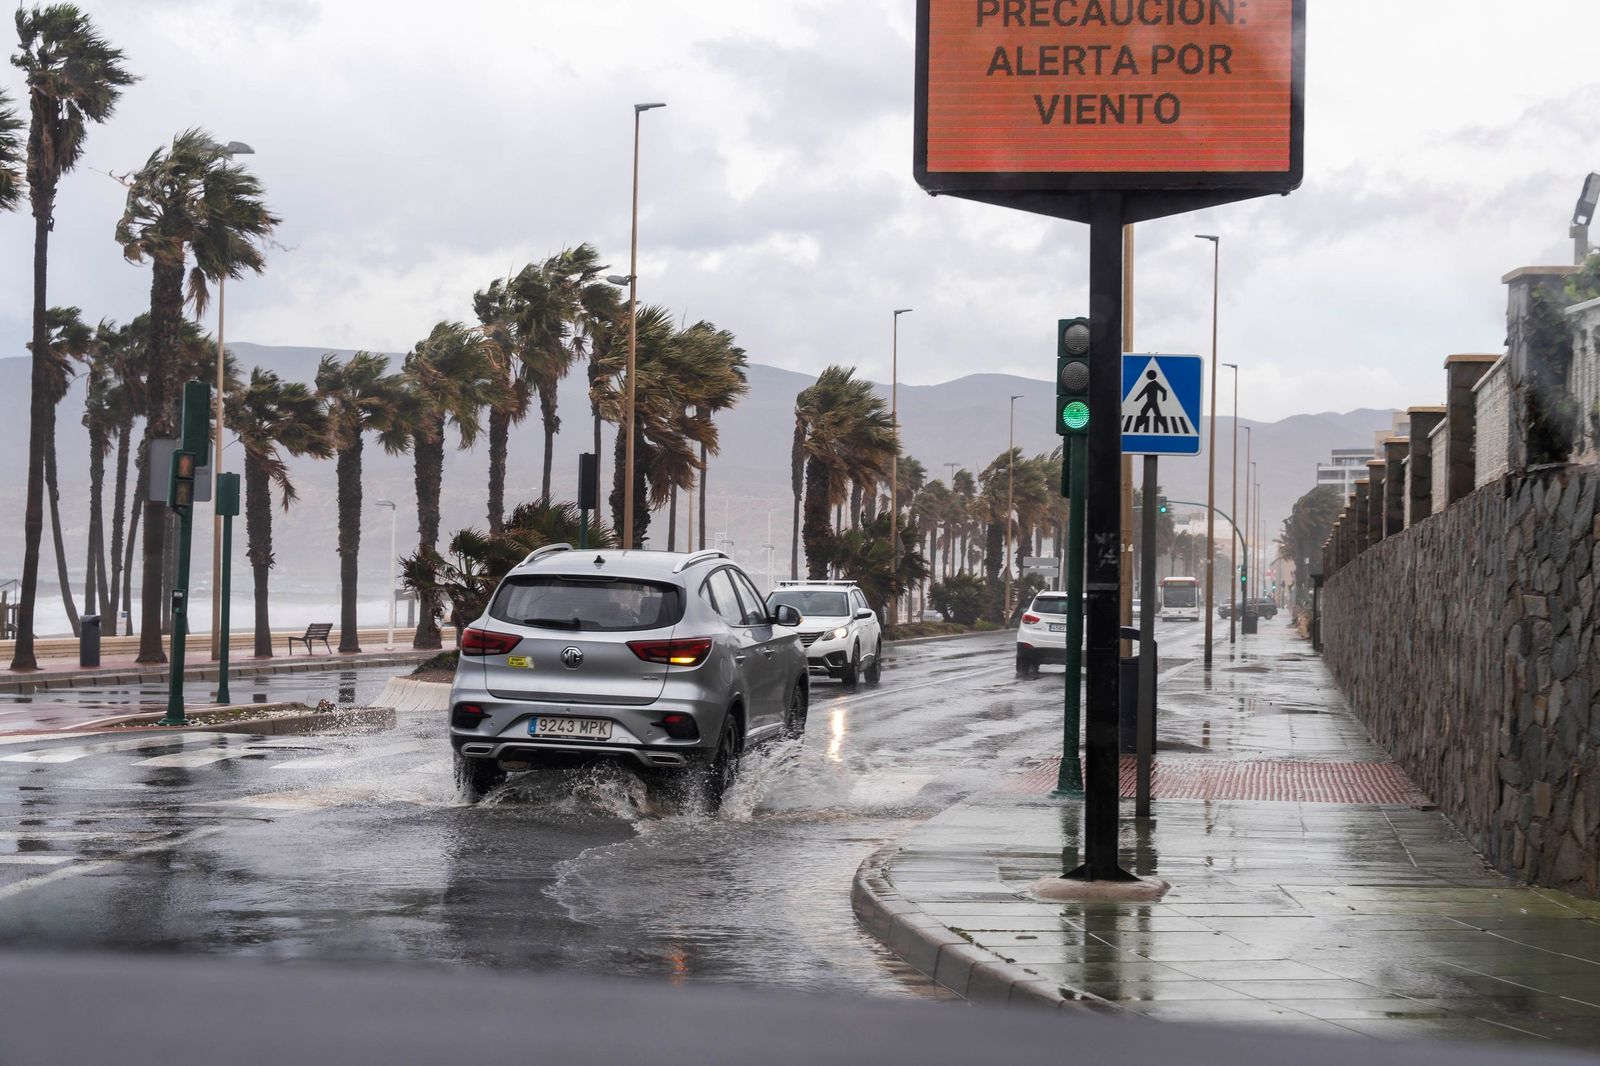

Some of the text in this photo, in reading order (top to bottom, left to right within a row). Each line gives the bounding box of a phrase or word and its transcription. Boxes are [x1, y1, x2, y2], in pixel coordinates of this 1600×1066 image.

[986, 43, 1233, 76] ALERTA POR
[1033, 92, 1181, 125] VIENTO
[562, 648, 582, 668] MG
[539, 718, 608, 735] 9243 MPK
